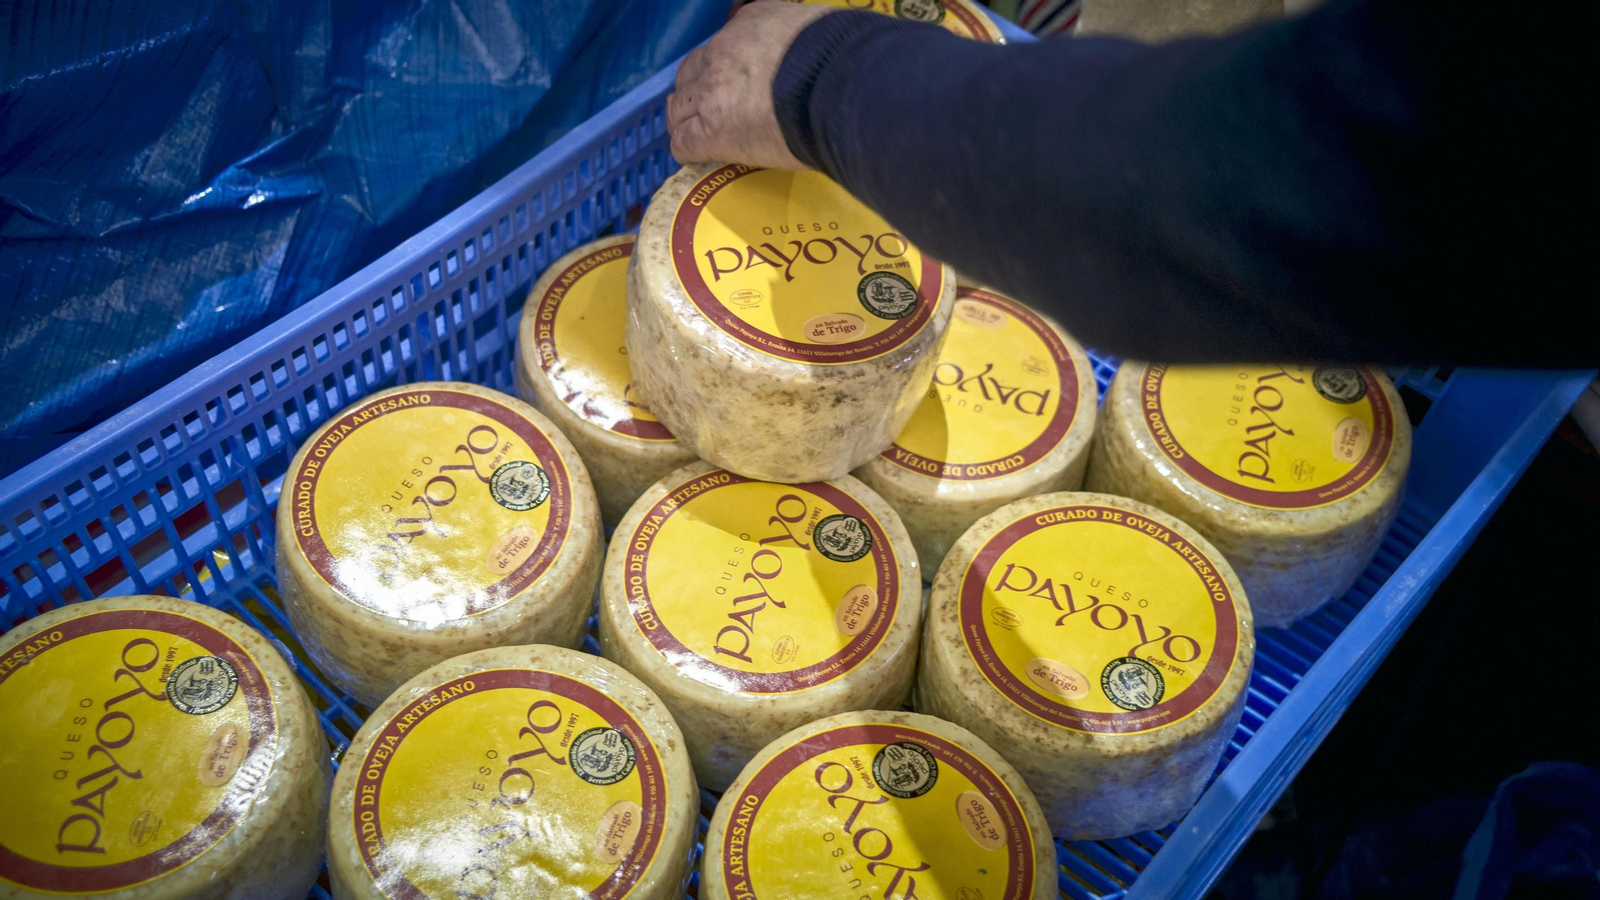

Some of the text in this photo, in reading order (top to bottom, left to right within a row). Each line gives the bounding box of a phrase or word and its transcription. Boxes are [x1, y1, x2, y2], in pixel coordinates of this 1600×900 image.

[690, 170, 735, 206] CURADO
[762, 221, 839, 236] QUESO
[561, 248, 623, 287] ARTESANO
[704, 232, 908, 283] PAYOYO
[542, 288, 564, 322] OVEJA
[824, 319, 848, 327] Salvado
[540, 324, 551, 341] DE
[812, 323, 857, 337] de Trigo
[928, 389, 983, 413] QUES
[933, 363, 1050, 416] PAYO
[1227, 372, 1249, 426] QUESO
[1146, 366, 1184, 460] CURADO DE OVEJ
[1237, 364, 1306, 484] PAYOY
[502, 442, 514, 457] 1997
[1344, 426, 1360, 458] de Trigo
[298, 394, 431, 538] CURADO DE OVEJA ARTESANO
[896, 450, 1025, 476] CURADO DE OVEJA
[381, 456, 433, 514] QUESO
[804, 506, 822, 536] desde 1997
[498, 536, 530, 570] de Trigo
[630, 473, 731, 632] CURADO DE OVEJA ARTESANO
[714, 532, 751, 596] QUESO
[1035, 508, 1227, 602] CURADO DE OVEJA ARTESANO
[713, 494, 811, 664] PAYOYO
[1073, 571, 1149, 609] QUESO
[846, 595, 858, 616] Salvado
[847, 594, 870, 630] de Trigo
[994, 562, 1202, 663] PAYOYO
[0, 631, 64, 677] TESANO
[159, 646, 179, 683] desde 1997
[1146, 655, 1186, 677] desde 1997
[1033, 667, 1078, 692] de Trigo
[1050, 668, 1076, 682] Salvado
[53, 698, 94, 781] QUESO
[56, 637, 168, 855] PAYOYO
[560, 712, 580, 748] desde 1997
[213, 764, 226, 778] de
[360, 680, 476, 857] RADO DE OVEJA ARTESANO
[464, 749, 499, 809] UESO
[850, 756, 876, 790] desde 1997
[650, 784, 658, 794] 956
[609, 810, 632, 856] de Trigo
[730, 794, 760, 877] ARTESANO
[966, 808, 988, 840] en Salvado
[970, 800, 1000, 842] de Trigo
